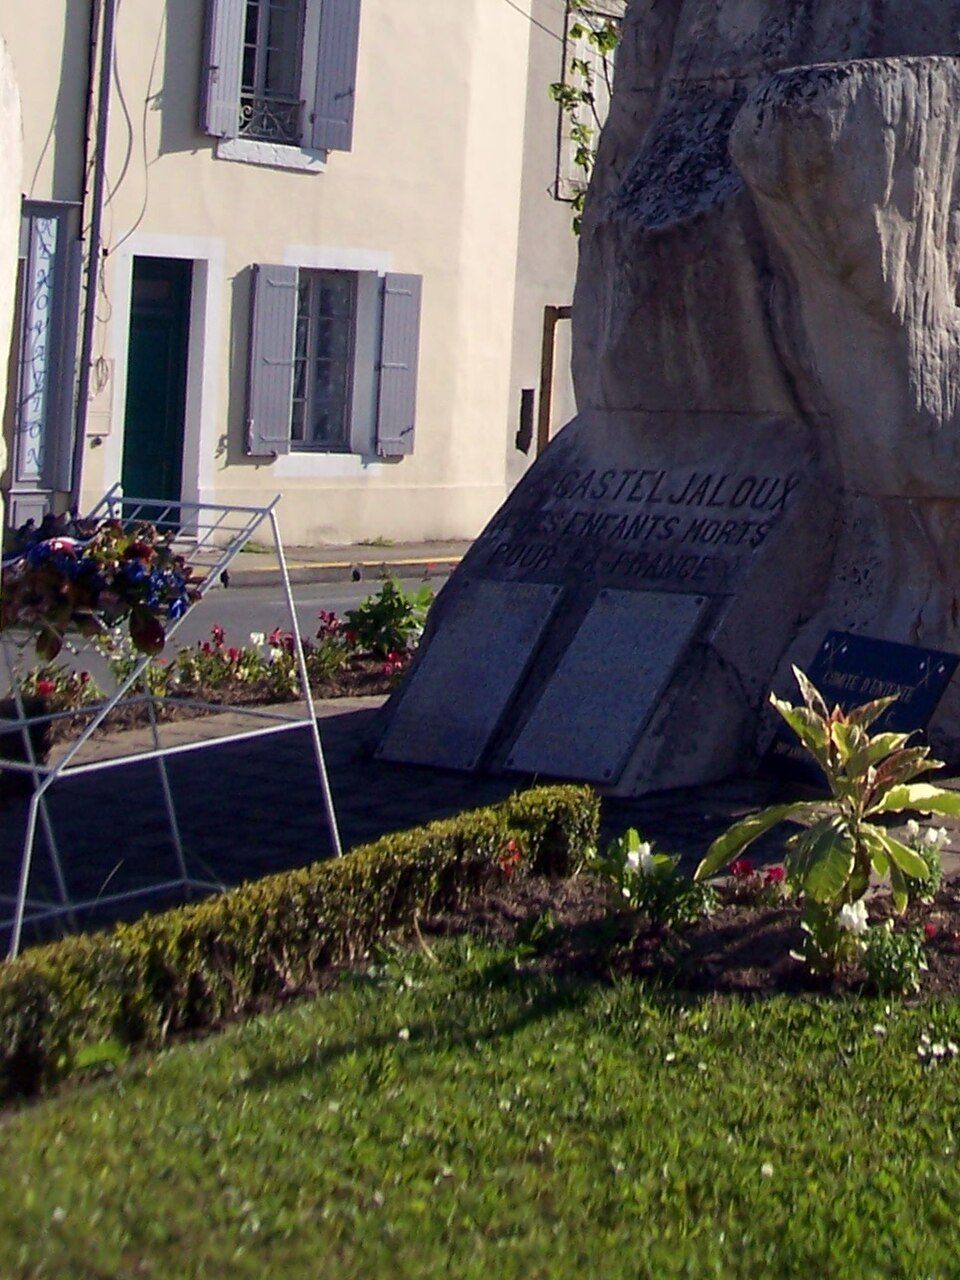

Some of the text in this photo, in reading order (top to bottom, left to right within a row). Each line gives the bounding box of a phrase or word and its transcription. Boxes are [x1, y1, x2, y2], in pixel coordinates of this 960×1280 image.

[563, 508, 681, 541] ENFANTS
[679, 517, 769, 549] MORTS
[485, 536, 559, 569] POUR
